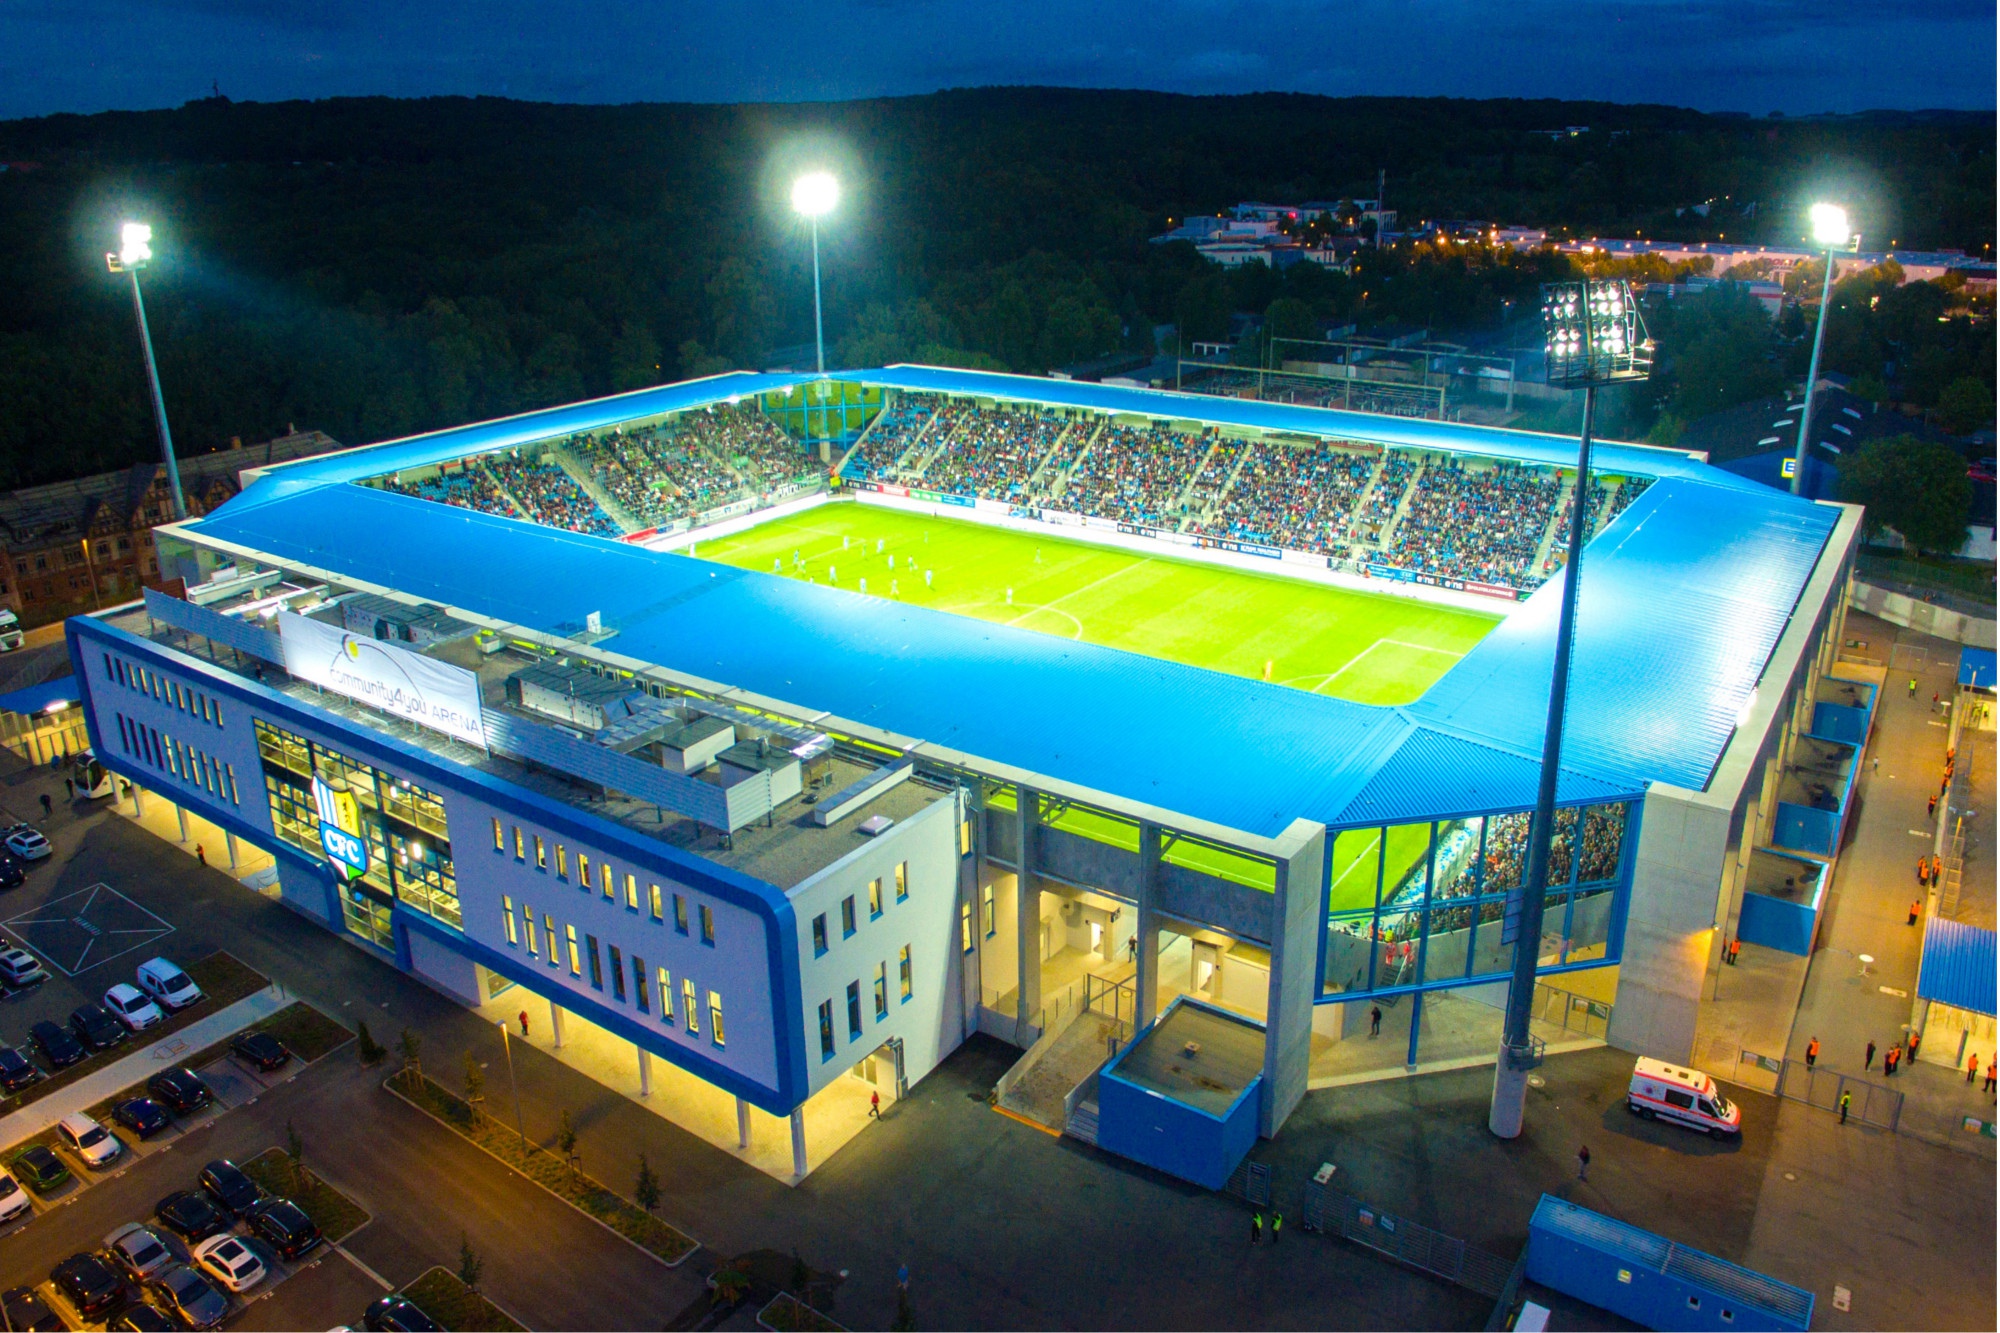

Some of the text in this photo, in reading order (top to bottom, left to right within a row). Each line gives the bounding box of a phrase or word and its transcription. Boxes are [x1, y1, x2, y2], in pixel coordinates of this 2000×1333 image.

[329, 667, 480, 735] community4you ARENA
[325, 829, 360, 864] CFC
